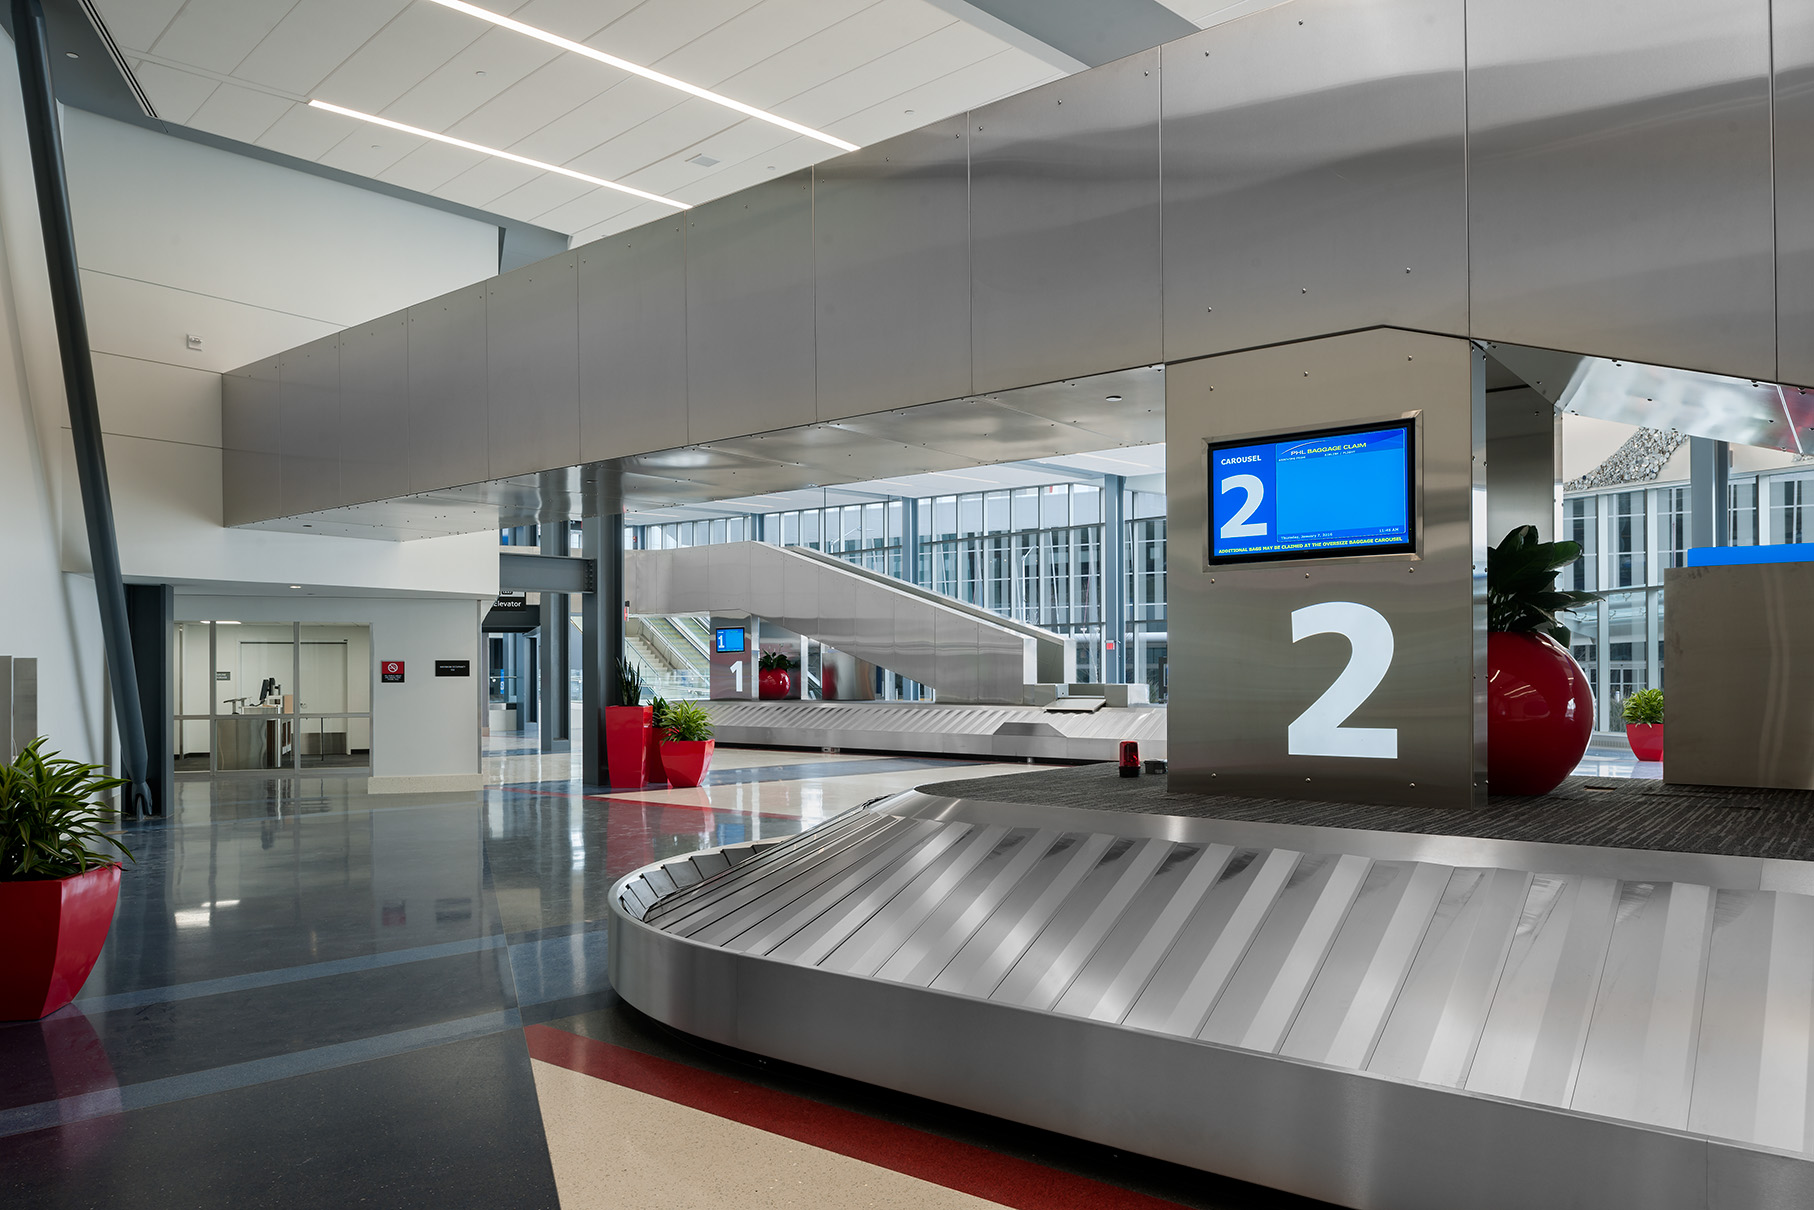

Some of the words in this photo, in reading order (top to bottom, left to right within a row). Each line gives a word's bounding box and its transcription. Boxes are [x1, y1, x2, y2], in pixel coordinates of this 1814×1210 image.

[1220, 455, 1262, 465] CAROUSEL
[1307, 446, 1342, 454] BAGGAGE
[1220, 474, 1267, 538] 2
[718, 635, 725, 648] 1
[730, 660, 743, 692] 1
[1288, 601, 1398, 759] 2
